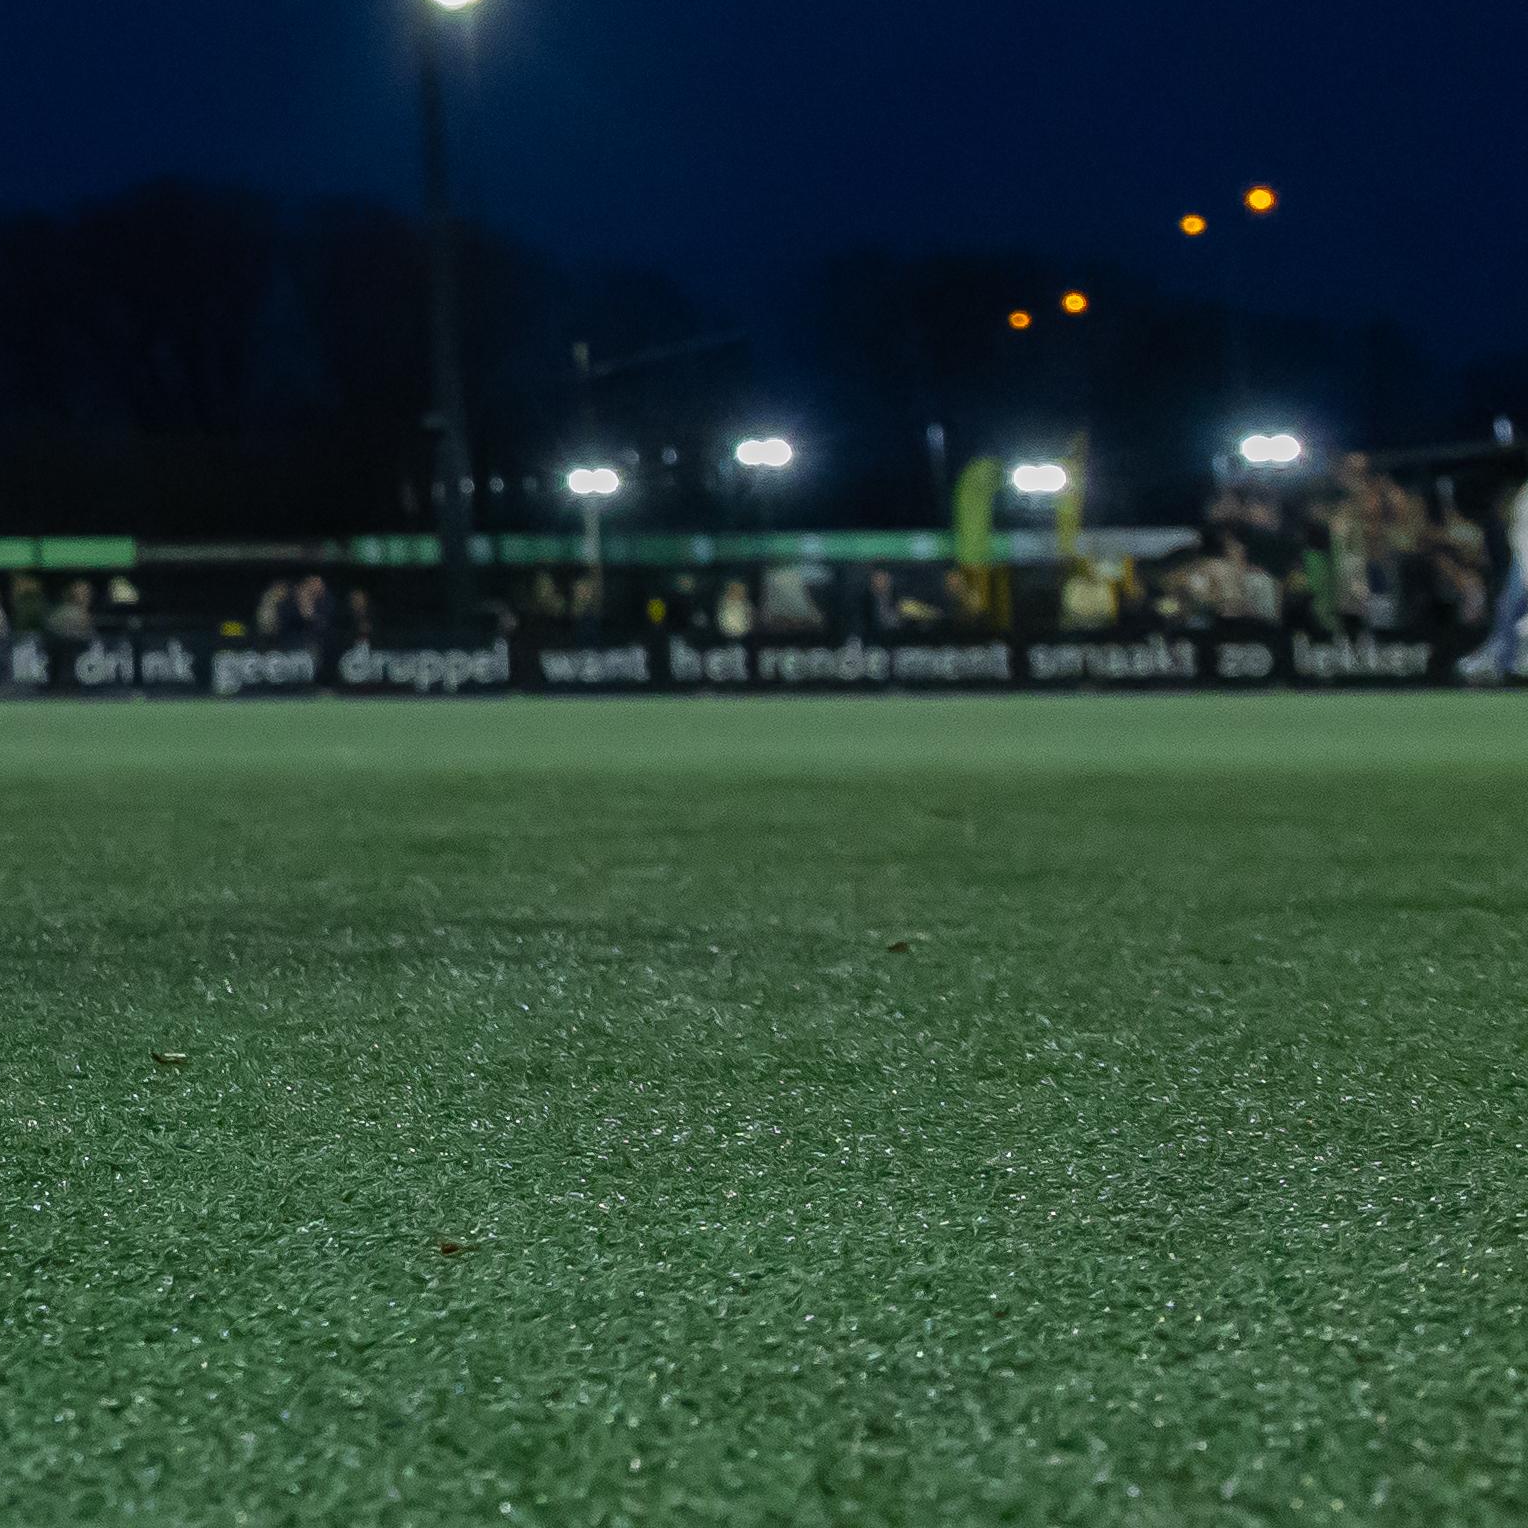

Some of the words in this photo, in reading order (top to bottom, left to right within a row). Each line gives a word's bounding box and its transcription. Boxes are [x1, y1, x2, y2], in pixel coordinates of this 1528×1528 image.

[74, 636, 194, 685] drink
[211, 648, 315, 695] geen
[340, 637, 510, 694] druppel
[540, 644, 649, 683] want
[669, 635, 748, 682] het
[757, 636, 1011, 681] rendement
[1026, 634, 1197, 680] smaakt
